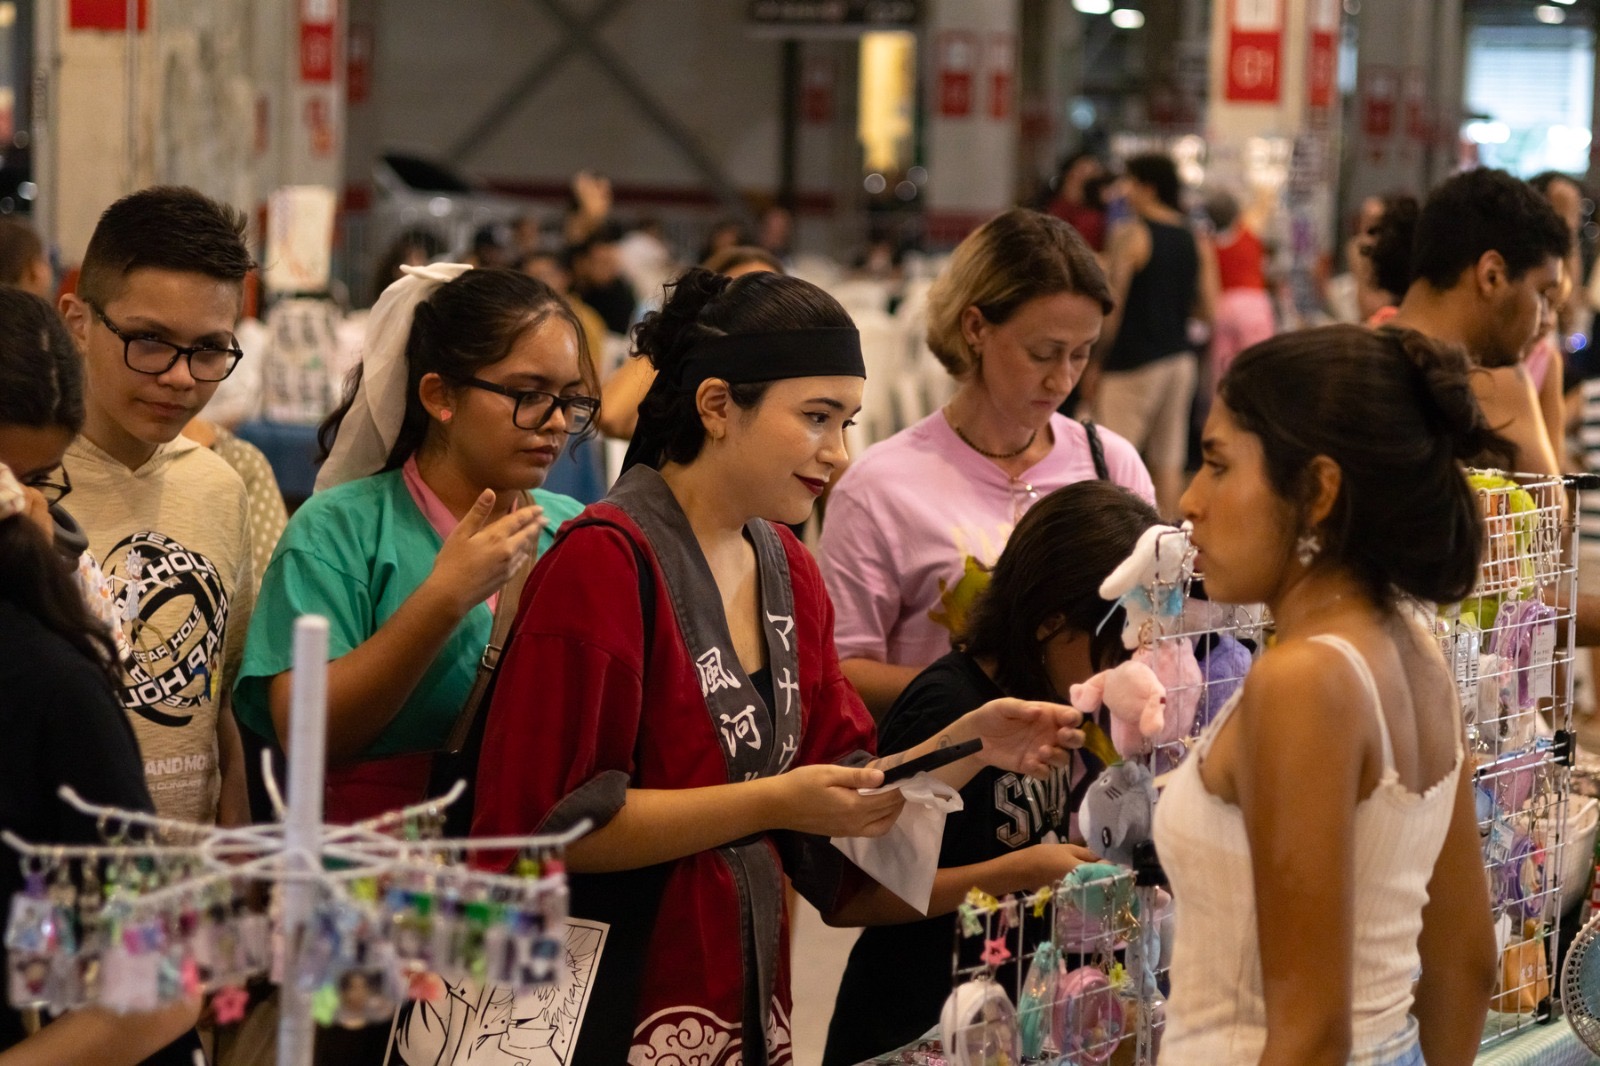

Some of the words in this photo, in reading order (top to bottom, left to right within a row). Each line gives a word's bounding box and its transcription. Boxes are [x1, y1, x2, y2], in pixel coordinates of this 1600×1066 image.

[146, 551, 218, 580] HOLE
[170, 604, 201, 649] HOLE
[145, 757, 183, 775] AND
